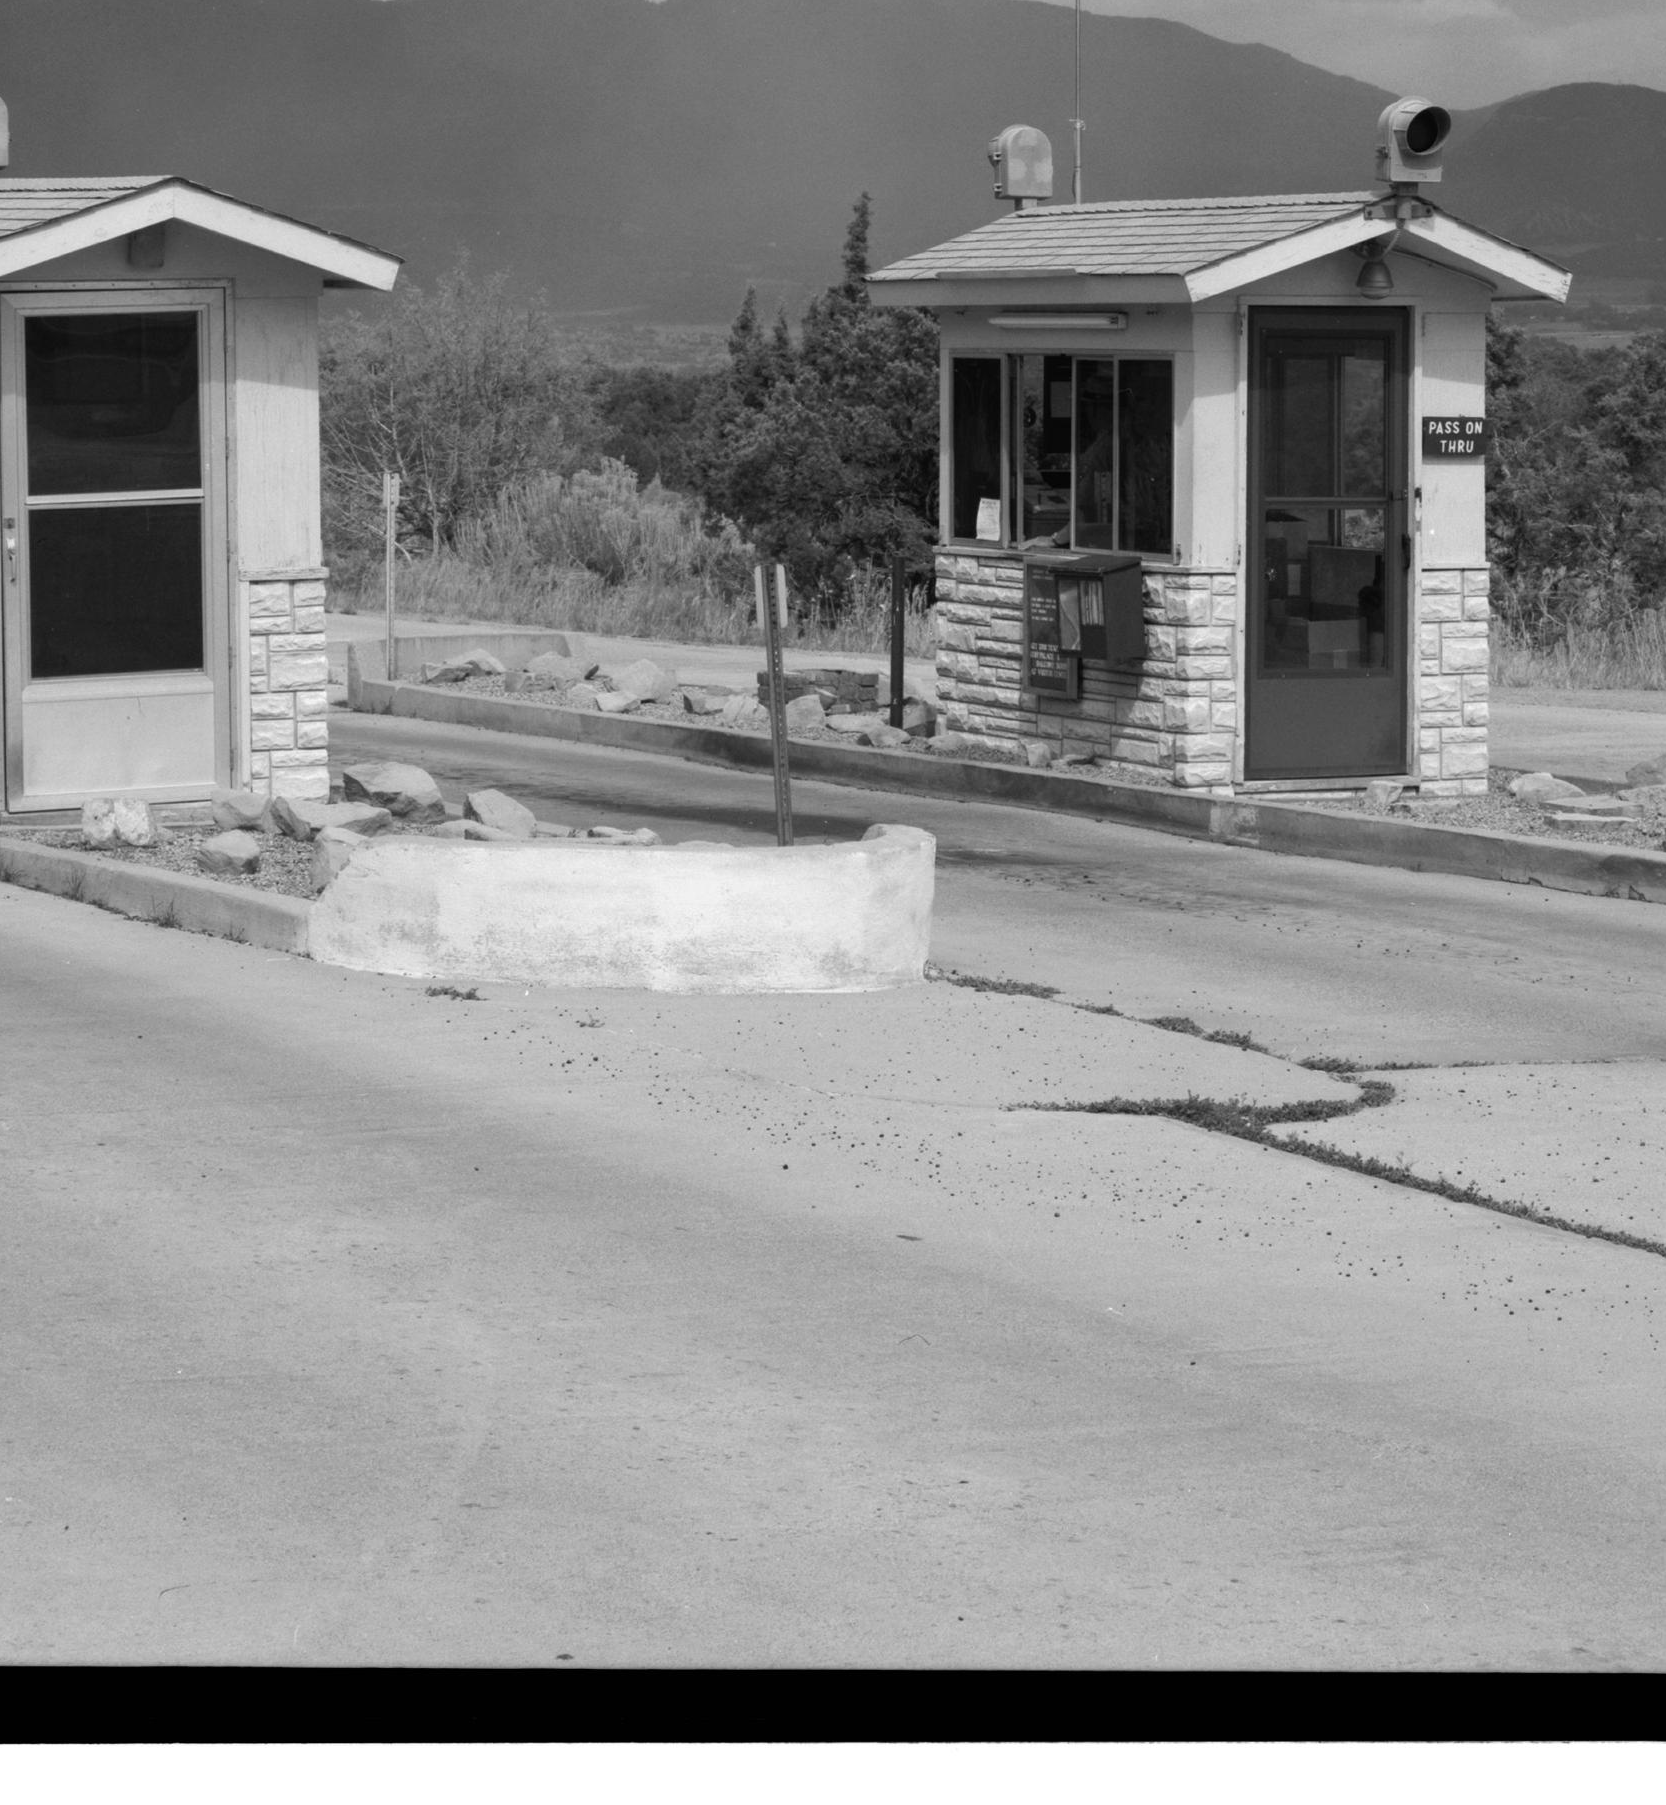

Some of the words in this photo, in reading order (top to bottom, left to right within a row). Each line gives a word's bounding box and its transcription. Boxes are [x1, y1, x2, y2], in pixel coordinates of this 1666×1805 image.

[1429, 421, 1459, 434] PASS
[1466, 422, 1482, 434] ON
[1441, 440, 1473, 452] THRU
